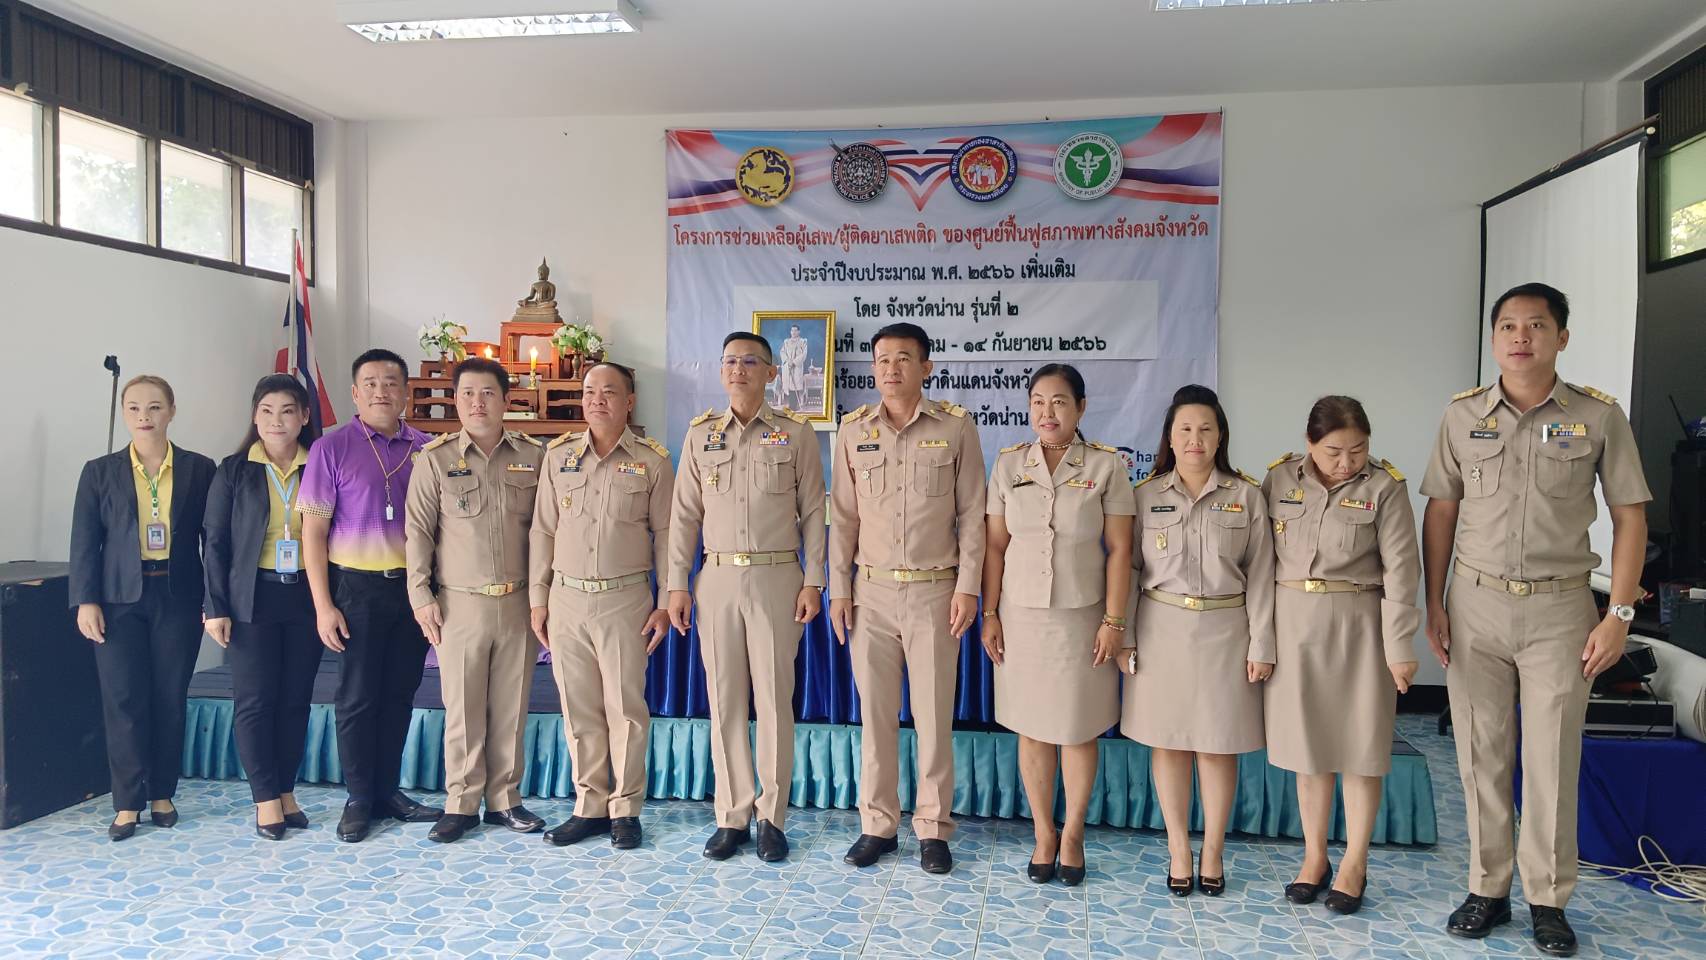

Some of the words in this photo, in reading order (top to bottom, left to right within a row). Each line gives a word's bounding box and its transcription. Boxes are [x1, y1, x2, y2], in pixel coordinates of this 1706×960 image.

[673, 223, 937, 252] โครงการช่วยเหลือผู้เสพ/ผู้ติดยาเสพติด
[943, 214, 1209, 249] ของศูนย์ฟื้นฟูสภาพทางสังคมจังหวัด
[791, 261, 926, 282] ประจำปีงบประมาณ
[931, 265, 963, 280] พ.ศ.
[968, 263, 1015, 280] ๒๕๖๖
[1021, 253, 1076, 279] เพิ่มเติม
[854, 296, 881, 317] โดย
[887, 297, 965, 317] จังหวัดน่าน
[971, 290, 1002, 323] รุ่นที่
[1007, 301, 1019, 316] ๒
[963, 338, 988, 352] ๑๔
[992, 331, 1053, 352] กันยายน
[1058, 334, 1107, 352] ๒๕๖๖
